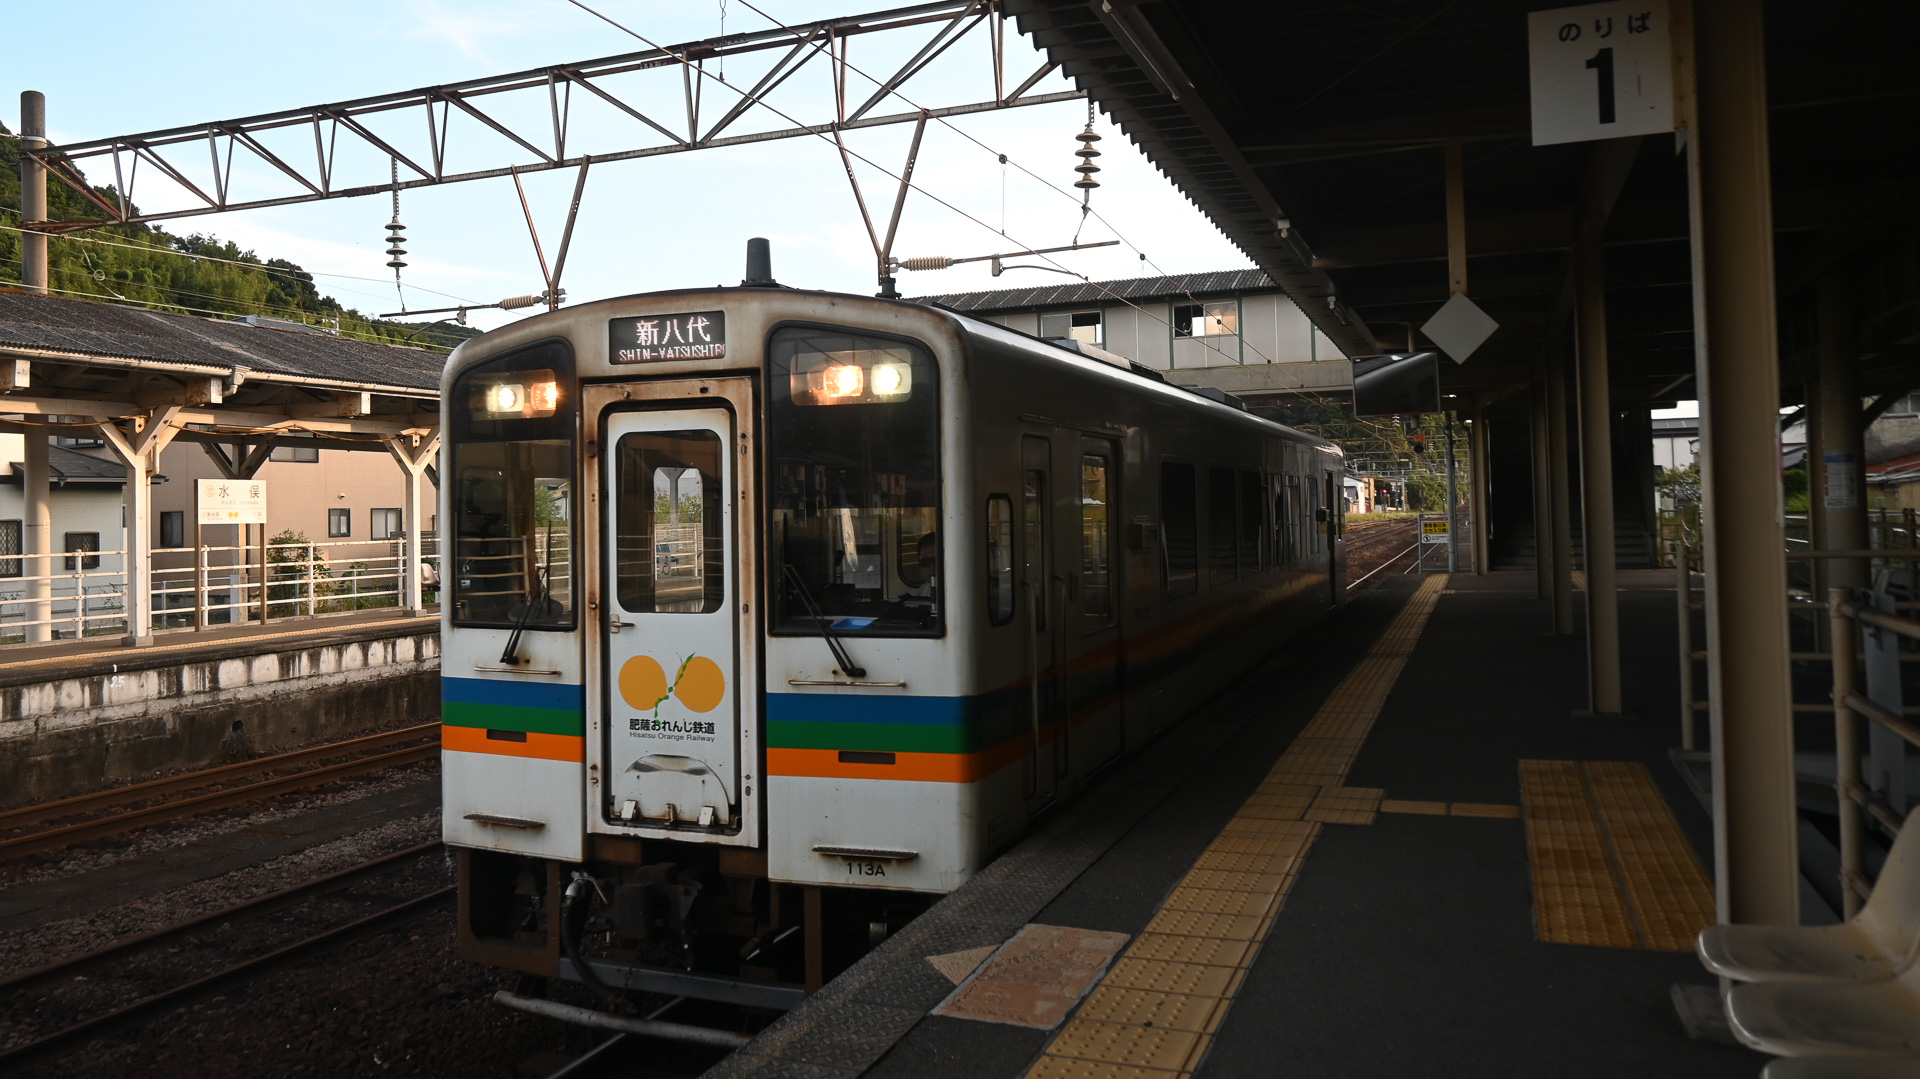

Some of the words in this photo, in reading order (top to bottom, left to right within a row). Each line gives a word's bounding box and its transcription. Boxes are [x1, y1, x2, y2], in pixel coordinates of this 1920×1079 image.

[1558, 11, 1652, 42] のりば
[1585, 47, 1616, 124] 1
[635, 316, 711, 346] 新八代
[218, 484, 260, 499] 水俣
[629, 718, 716, 735] 肥薩おれんじ鉄道
[629, 731, 656, 739] Hisatsu
[657, 732, 685, 742] Orange
[686, 734, 716, 744] Railway
[847, 862, 886, 877] 113A
